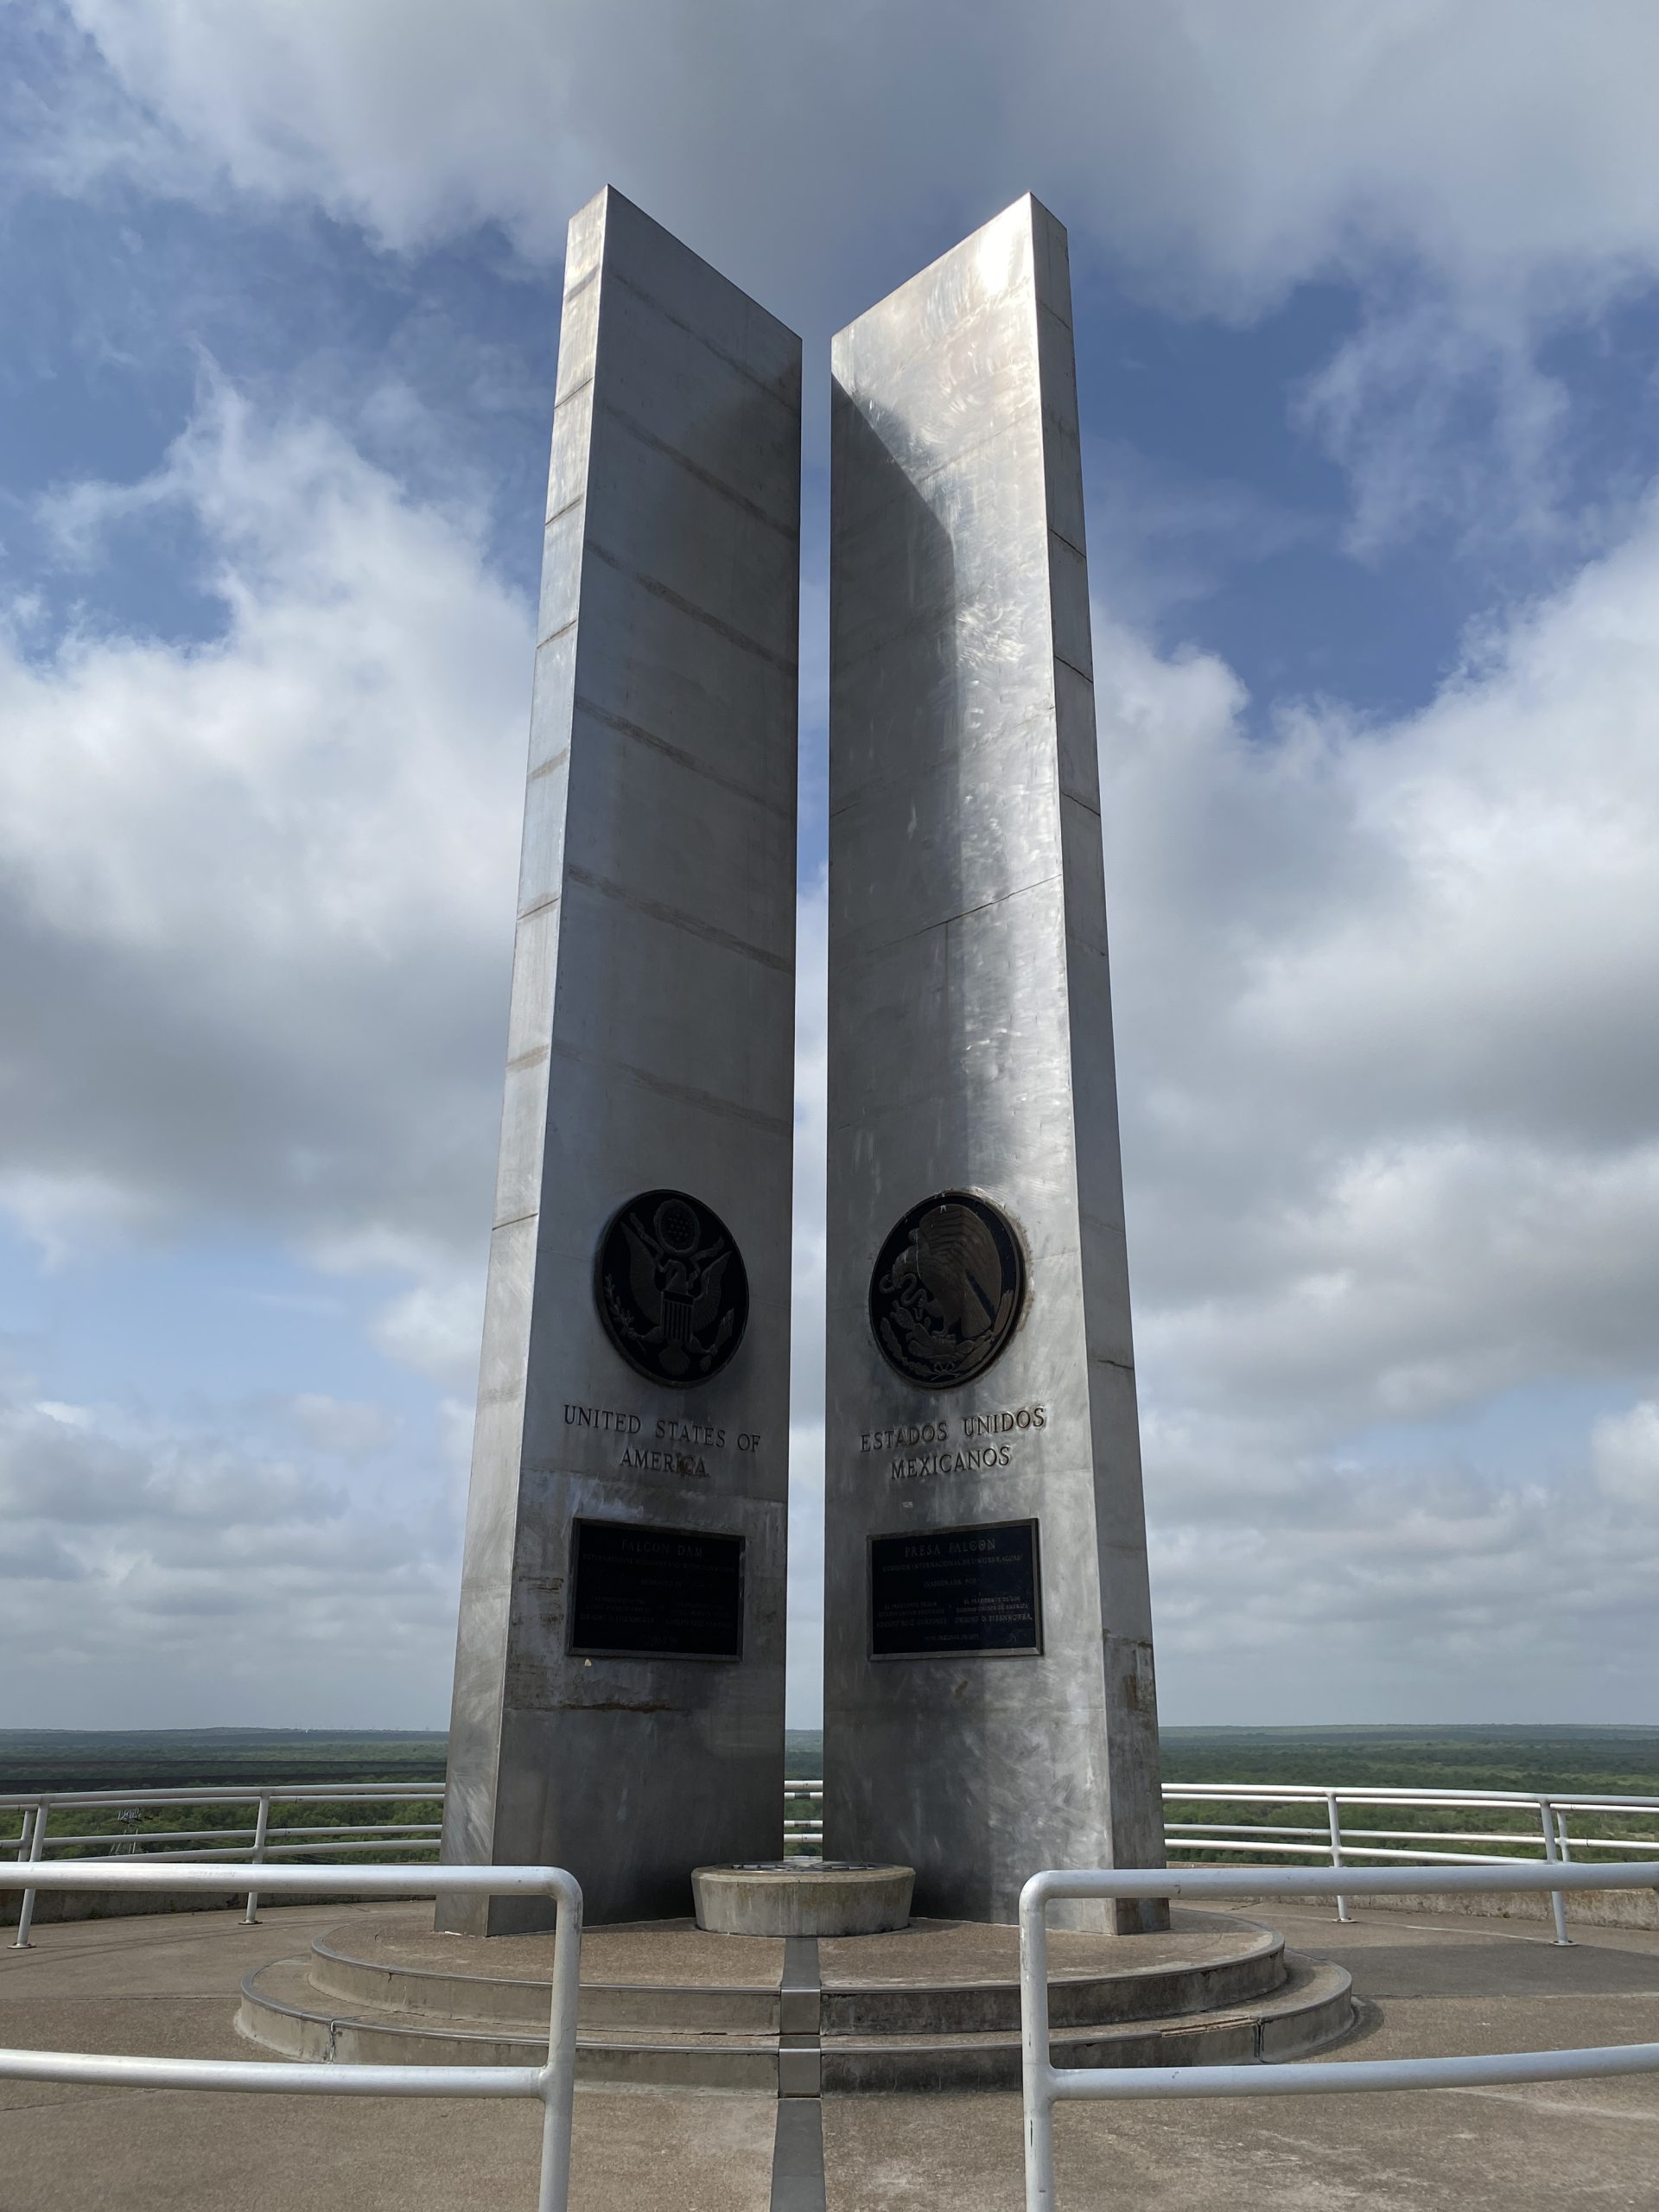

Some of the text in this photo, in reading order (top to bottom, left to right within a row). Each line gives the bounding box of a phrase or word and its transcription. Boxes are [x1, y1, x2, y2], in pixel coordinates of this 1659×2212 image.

[563, 1404, 761, 1452] UNITED STATES OF
[861, 1408, 1045, 1453] ESTADOS UNIDOS
[620, 1448, 709, 1478] AMERICA
[891, 1446, 1010, 1479] MEXICANOS
[621, 1539, 703, 1557] FALCON DAM
[905, 1543, 941, 1558] PRESA
